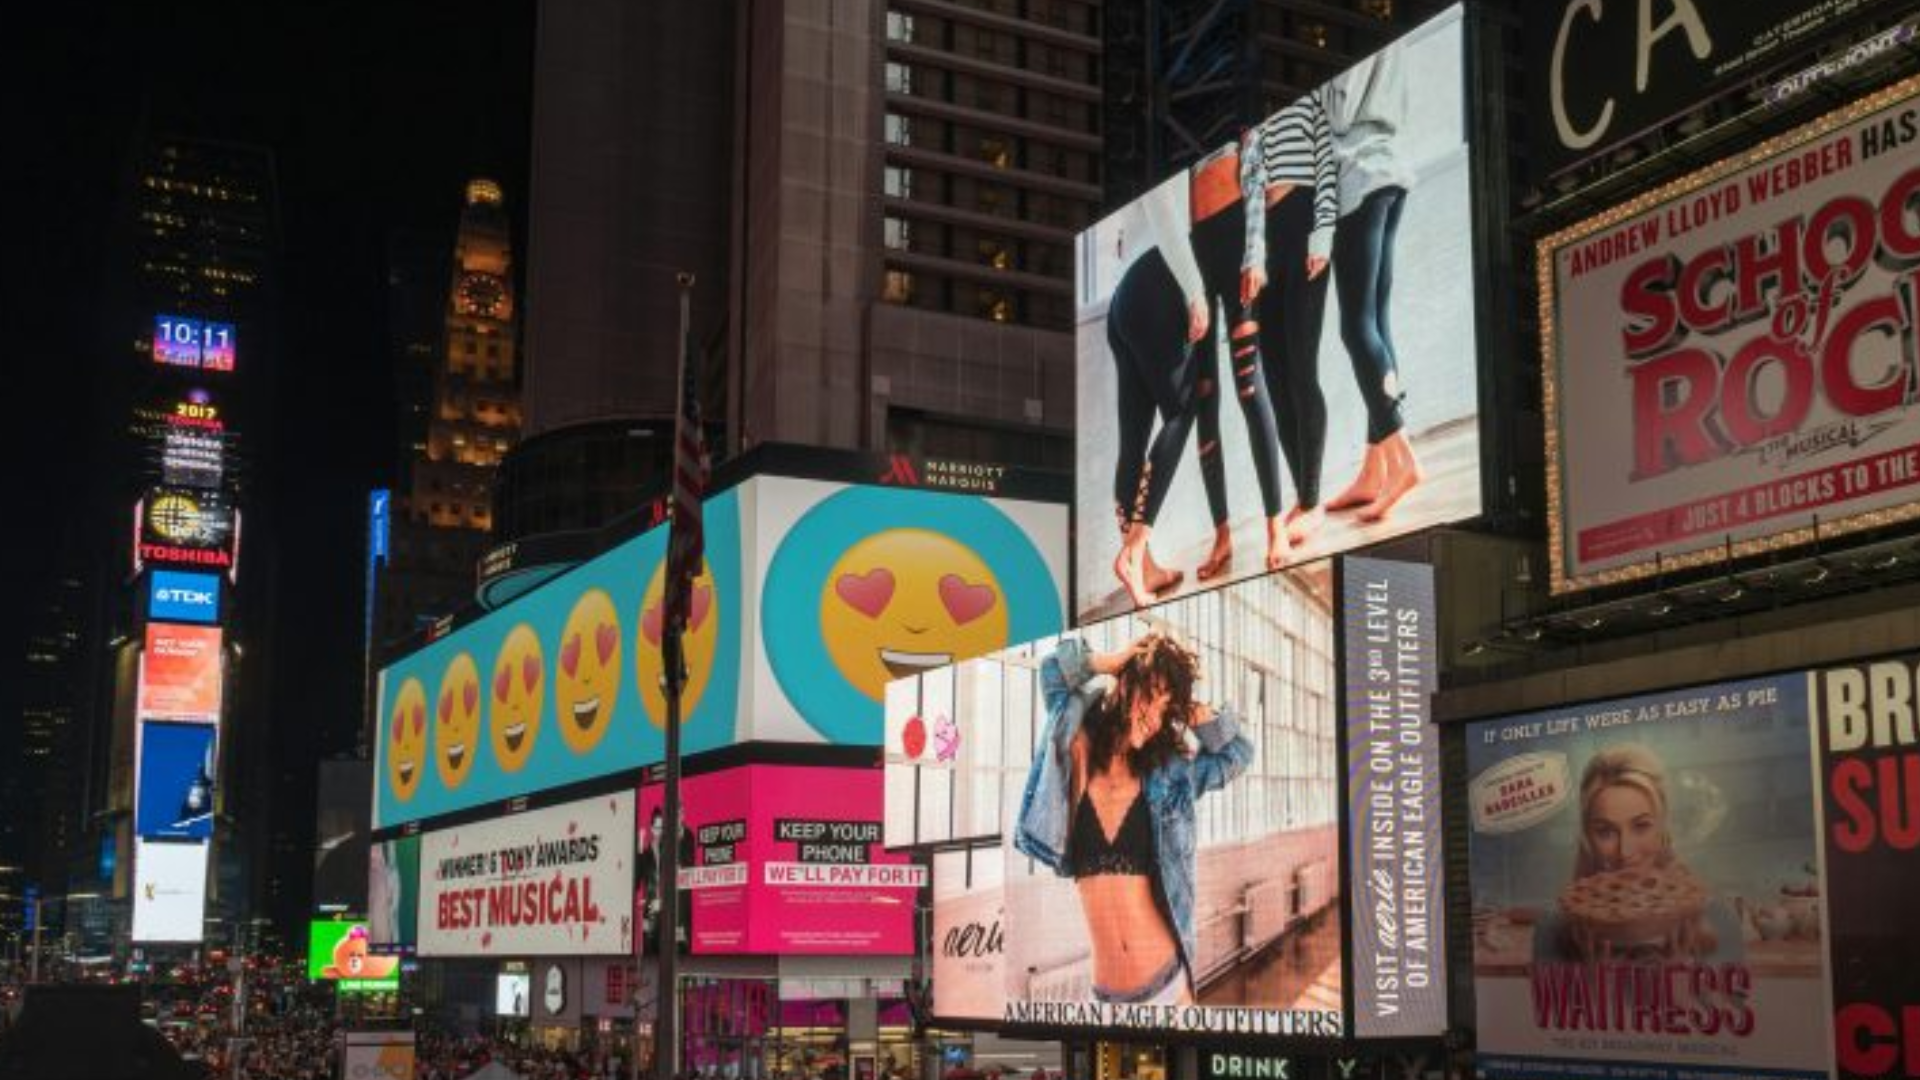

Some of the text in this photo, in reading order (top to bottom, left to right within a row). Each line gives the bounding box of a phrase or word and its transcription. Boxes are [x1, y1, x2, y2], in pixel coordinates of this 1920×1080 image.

[1668, 185, 1741, 238] LLOYD
[1748, 137, 1854, 205] WEBBER
[1862, 109, 1919, 159] HAS
[1772, 266, 1844, 353] of
[160, 321, 229, 349] 10:11
[1628, 270, 1920, 483] ROC
[177, 402, 216, 419] 2017
[1787, 423, 1860, 461] MUSICAL
[927, 461, 1004, 478] MARRIOTT
[927, 475, 995, 491] MARQUIS
[1683, 504, 1731, 532] JUST
[1755, 474, 1835, 514] BLOCKS
[1842, 466, 1869, 494] TO
[1876, 451, 1919, 485] THE
[142, 545, 230, 566] TOSHIBA
[170, 589, 212, 604] TDK
[1366, 579, 1389, 642] LEVEL
[1369, 690, 1391, 732] THE
[1502, 723, 1541, 741] ONLY
[1546, 718, 1580, 735] LIFE
[1585, 710, 1632, 729] WERE
[1637, 704, 1659, 721] AS
[1665, 698, 1711, 718] EASY
[1717, 692, 1742, 711] AS
[1747, 686, 1777, 708] PIE
[1827, 660, 1920, 752] BR
[1370, 741, 1393, 773] ON
[1396, 608, 1428, 988] OF AMERICAN EAGLE OUTFITTERS
[780, 823, 880, 842] KEEP YOUR
[1371, 780, 1396, 860] INSIDE
[500, 845, 535, 874] TONY
[537, 835, 598, 868] AWARDS
[802, 844, 865, 862] PHONE
[769, 867, 924, 885] WE'LL PAY FOR IT
[438, 888, 486, 930] BEST
[1366, 869, 1398, 949] aerie
[1376, 953, 1399, 1016] VISIT
[1531, 961, 1755, 1037] WAITRESS
[1004, 1001, 1342, 1037] AMERICAN EAGLE OUTFITTERS
[1212, 1054, 1289, 1080] DRINK
